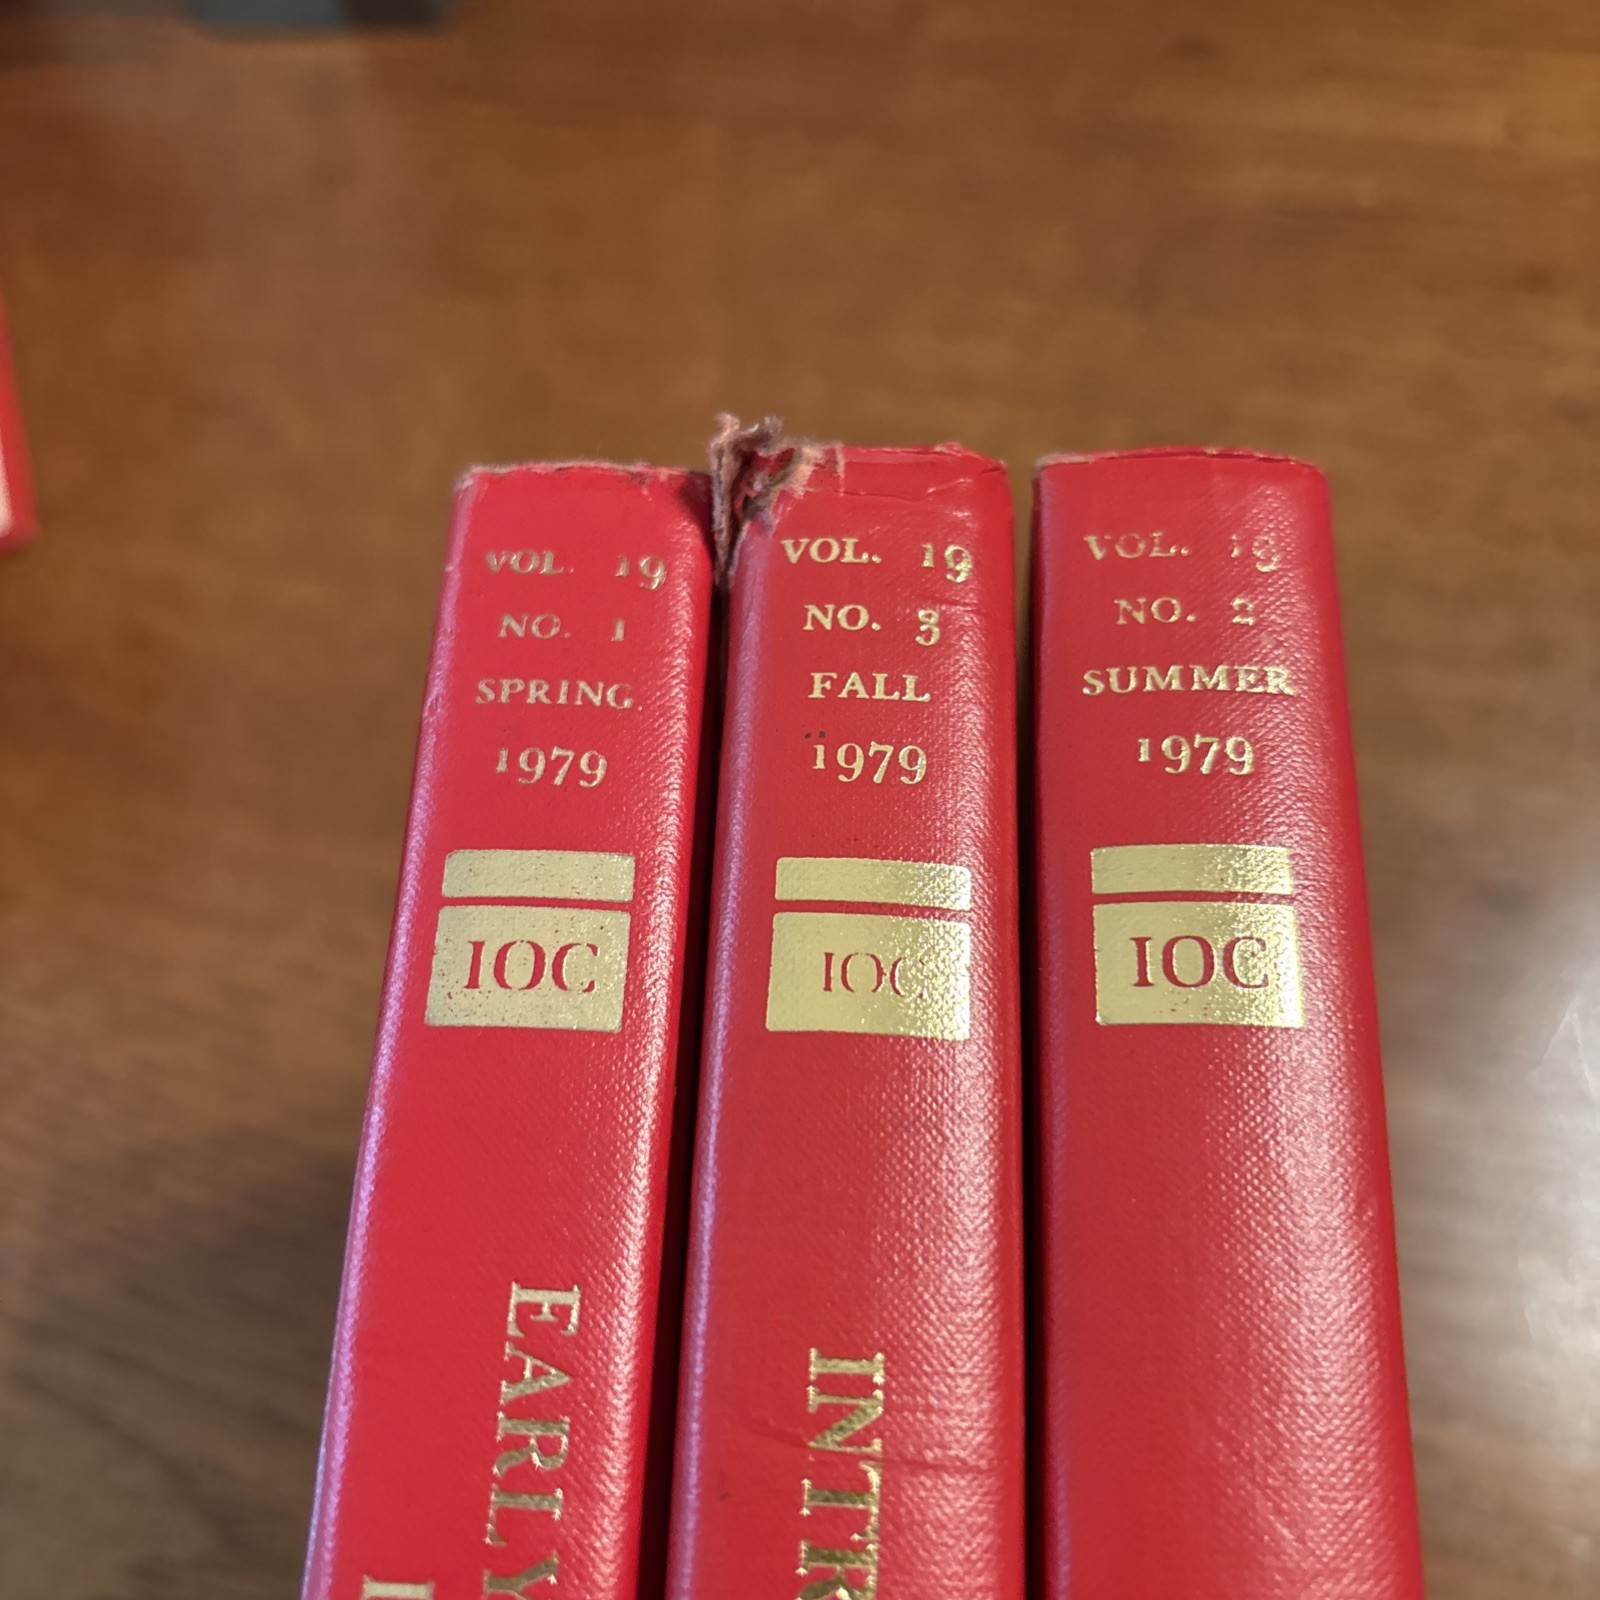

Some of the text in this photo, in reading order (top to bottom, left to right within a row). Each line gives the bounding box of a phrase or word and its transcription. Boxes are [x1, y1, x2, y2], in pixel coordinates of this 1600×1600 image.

[486, 550, 668, 590] VOL. 19
[781, 538, 974, 583] VOL. 19
[1083, 531, 1280, 573] VOL. 19
[498, 613, 627, 642] NO. 1
[803, 604, 941, 646] NO. 3
[1114, 597, 1255, 626] NO. 2
[808, 672, 932, 703] FALL
[1082, 664, 1297, 697] SUMMER
[495, 746, 608, 788] 1979
[812, 741, 928, 785] 1979
[1137, 734, 1256, 776] 1979
[464, 939, 600, 994] IOC
[823, 951, 929, 998] IOC
[1132, 934, 1270, 988] IOC
